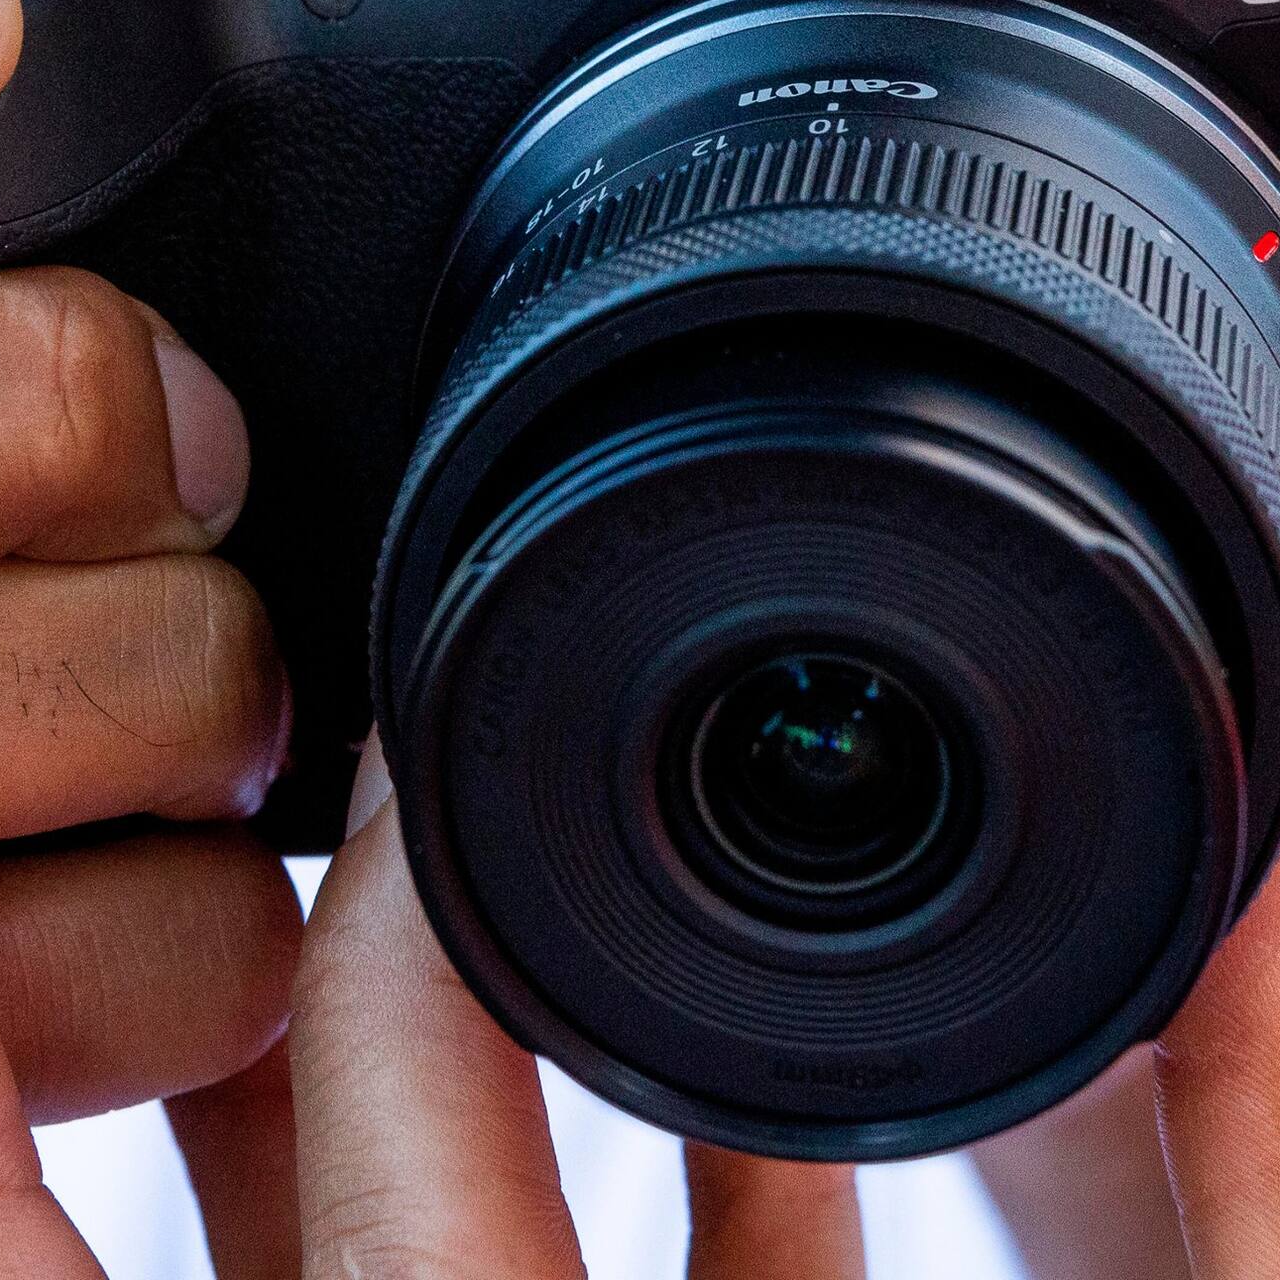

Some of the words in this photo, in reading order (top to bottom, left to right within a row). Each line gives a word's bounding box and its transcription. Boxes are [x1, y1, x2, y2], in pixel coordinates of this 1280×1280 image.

[738, 78, 938, 107] Canon
[808, 118, 849, 135] 10
[691, 134, 728, 157] 12
[578, 186, 609, 215] 14
